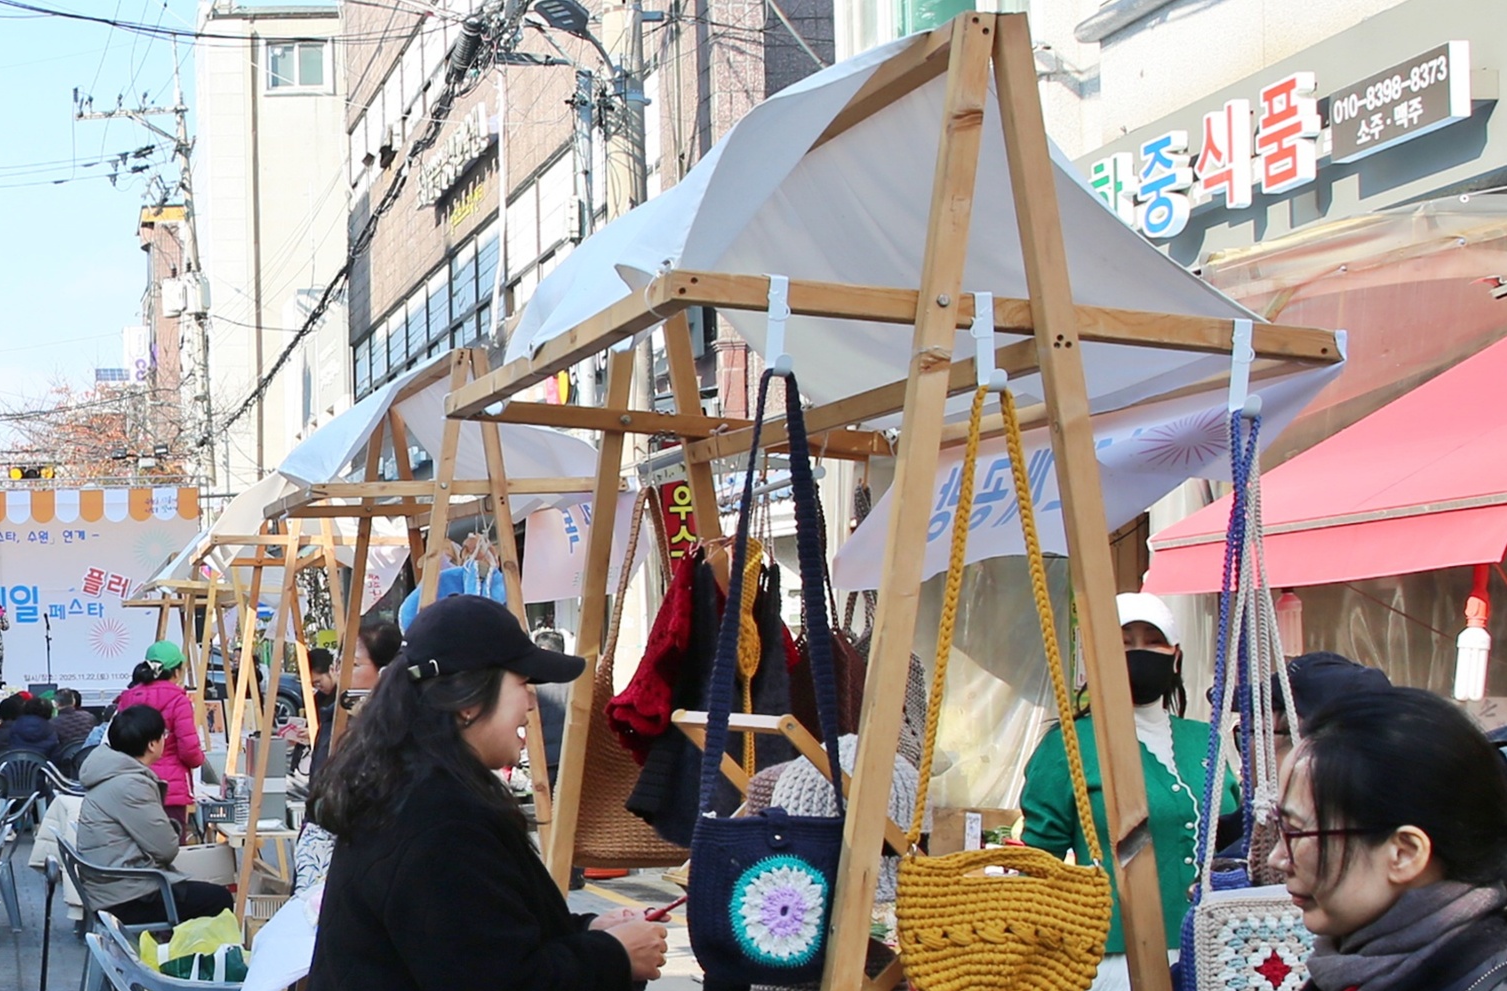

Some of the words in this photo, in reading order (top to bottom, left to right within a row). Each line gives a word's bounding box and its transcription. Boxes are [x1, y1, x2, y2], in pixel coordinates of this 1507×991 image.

[1333, 55, 1448, 124] 010-8398-8373
[62, 529, 86, 543] 연계
[82, 567, 144, 599] 플러
[48, 598, 104, 620] 페스타
